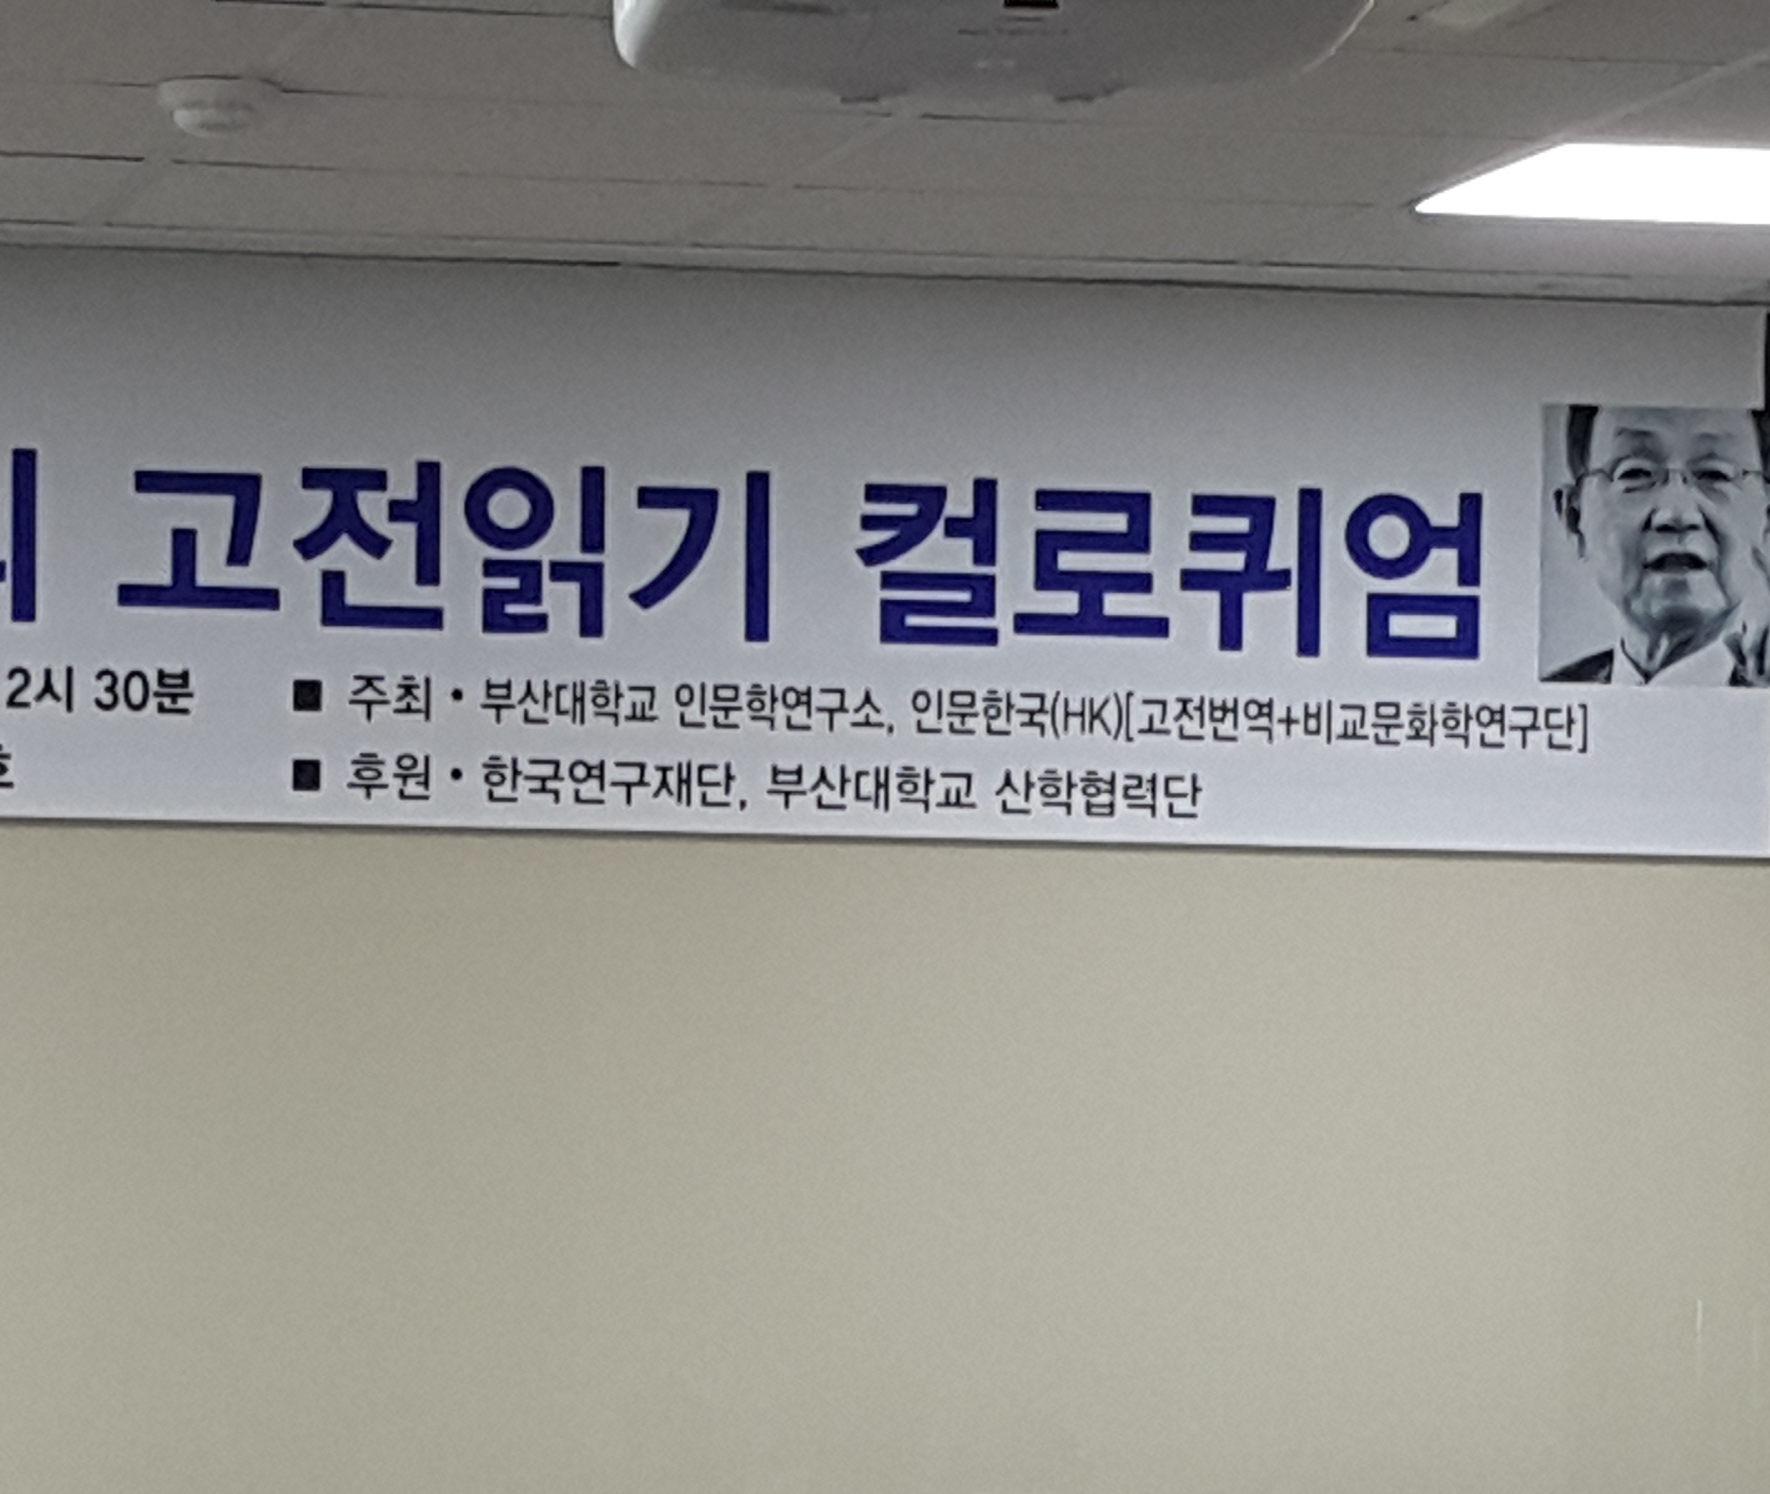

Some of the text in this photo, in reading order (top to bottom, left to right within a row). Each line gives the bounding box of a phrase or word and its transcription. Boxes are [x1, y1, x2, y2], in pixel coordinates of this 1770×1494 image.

[117, 460, 770, 642] 고전읽기
[855, 477, 1483, 660] 컬로퀴엄
[6, 666, 73, 713] 2시
[94, 668, 194, 715] 30분
[349, 675, 431, 722] 주최
[481, 679, 658, 727] 부산대학교
[675, 682, 893, 733] 인문학연구소,
[347, 753, 1202, 818] 후원 한국연구재단, 부산대학교 산학협력단
